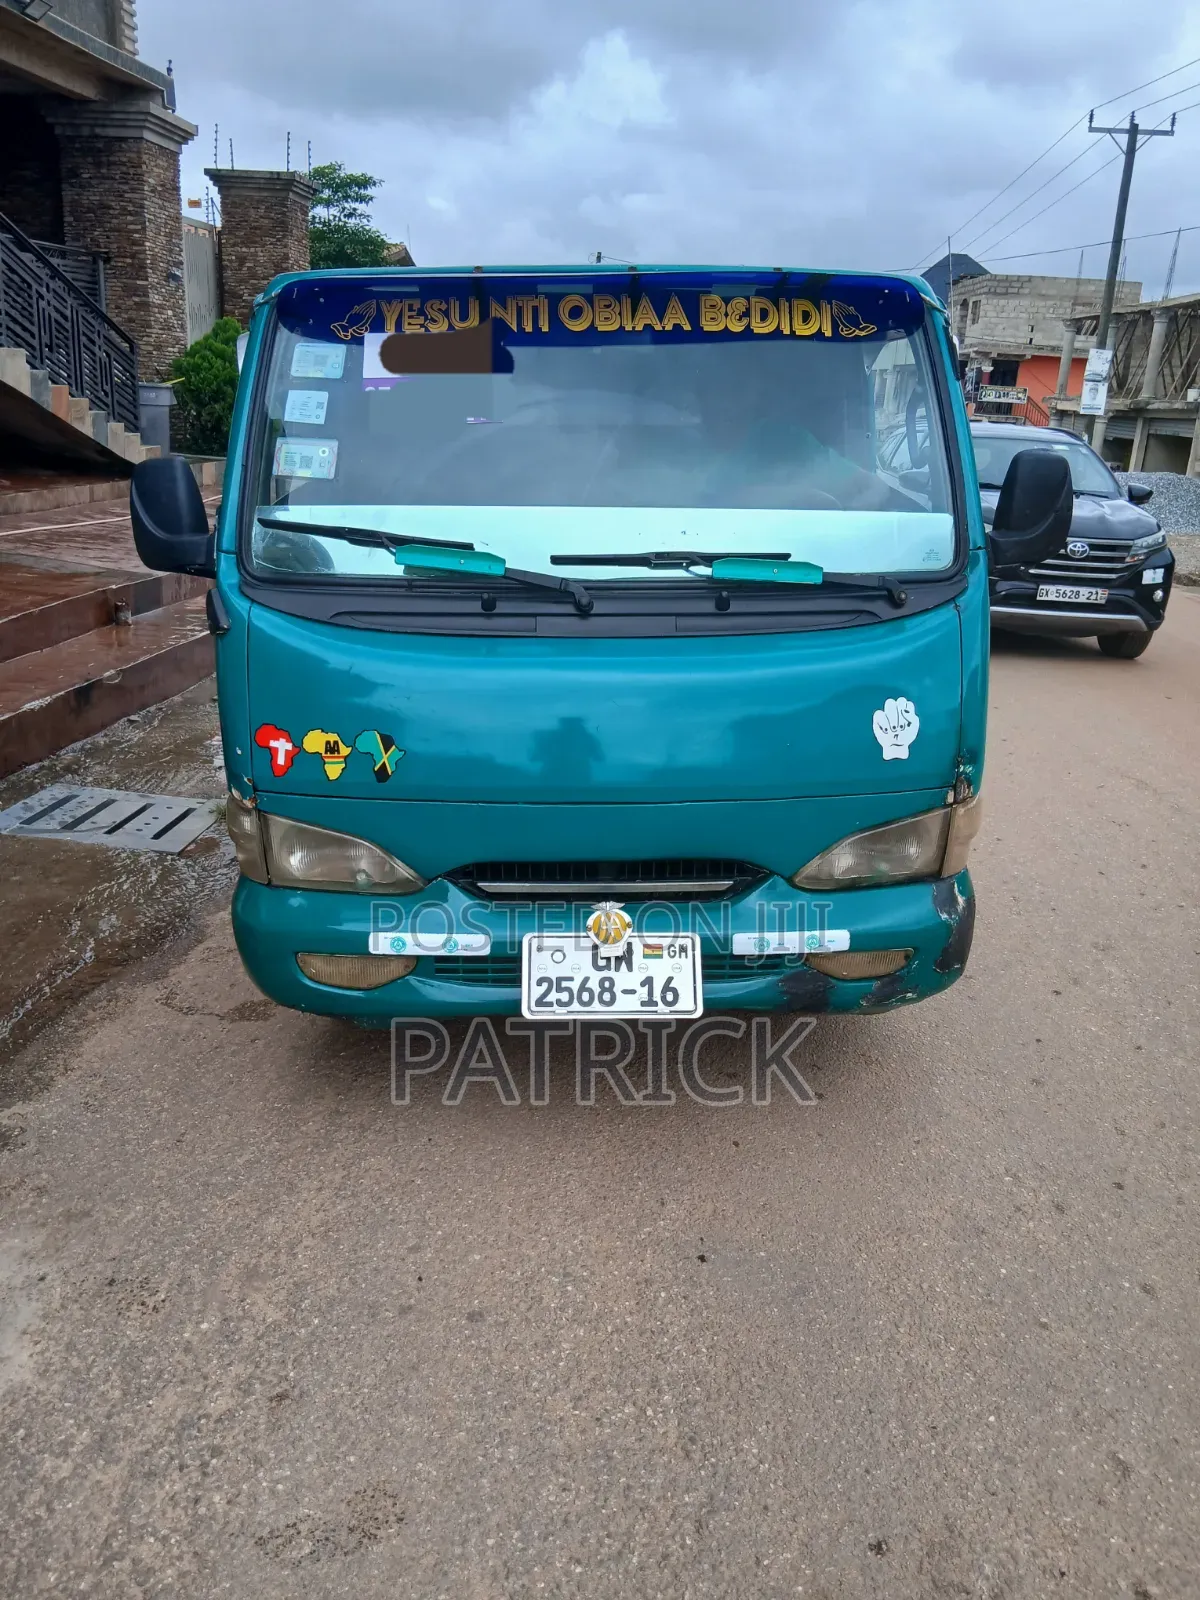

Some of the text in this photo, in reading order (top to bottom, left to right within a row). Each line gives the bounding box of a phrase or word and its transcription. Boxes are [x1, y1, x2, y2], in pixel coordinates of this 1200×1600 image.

[379, 296, 479, 333] YESU
[490, 294, 549, 332] NTI
[558, 292, 692, 332] OBIAA
[1038, 588, 1050, 598] GX
[324, 740, 341, 755] AA
[534, 976, 680, 1008] 2568-16
